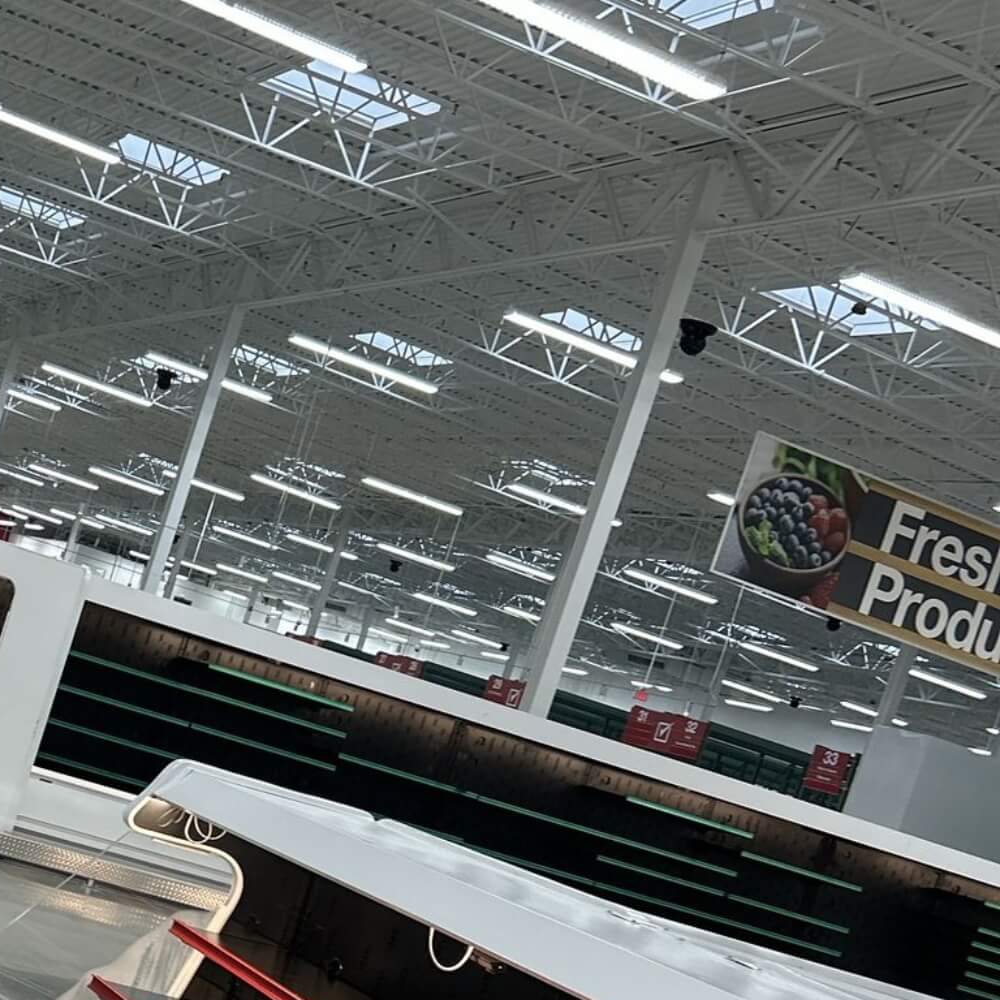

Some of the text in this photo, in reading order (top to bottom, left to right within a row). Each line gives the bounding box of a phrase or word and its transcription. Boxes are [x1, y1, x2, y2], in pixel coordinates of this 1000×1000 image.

[859, 562, 1000, 663] Produ
[684, 720, 699, 734] 32
[822, 750, 839, 766] 33
